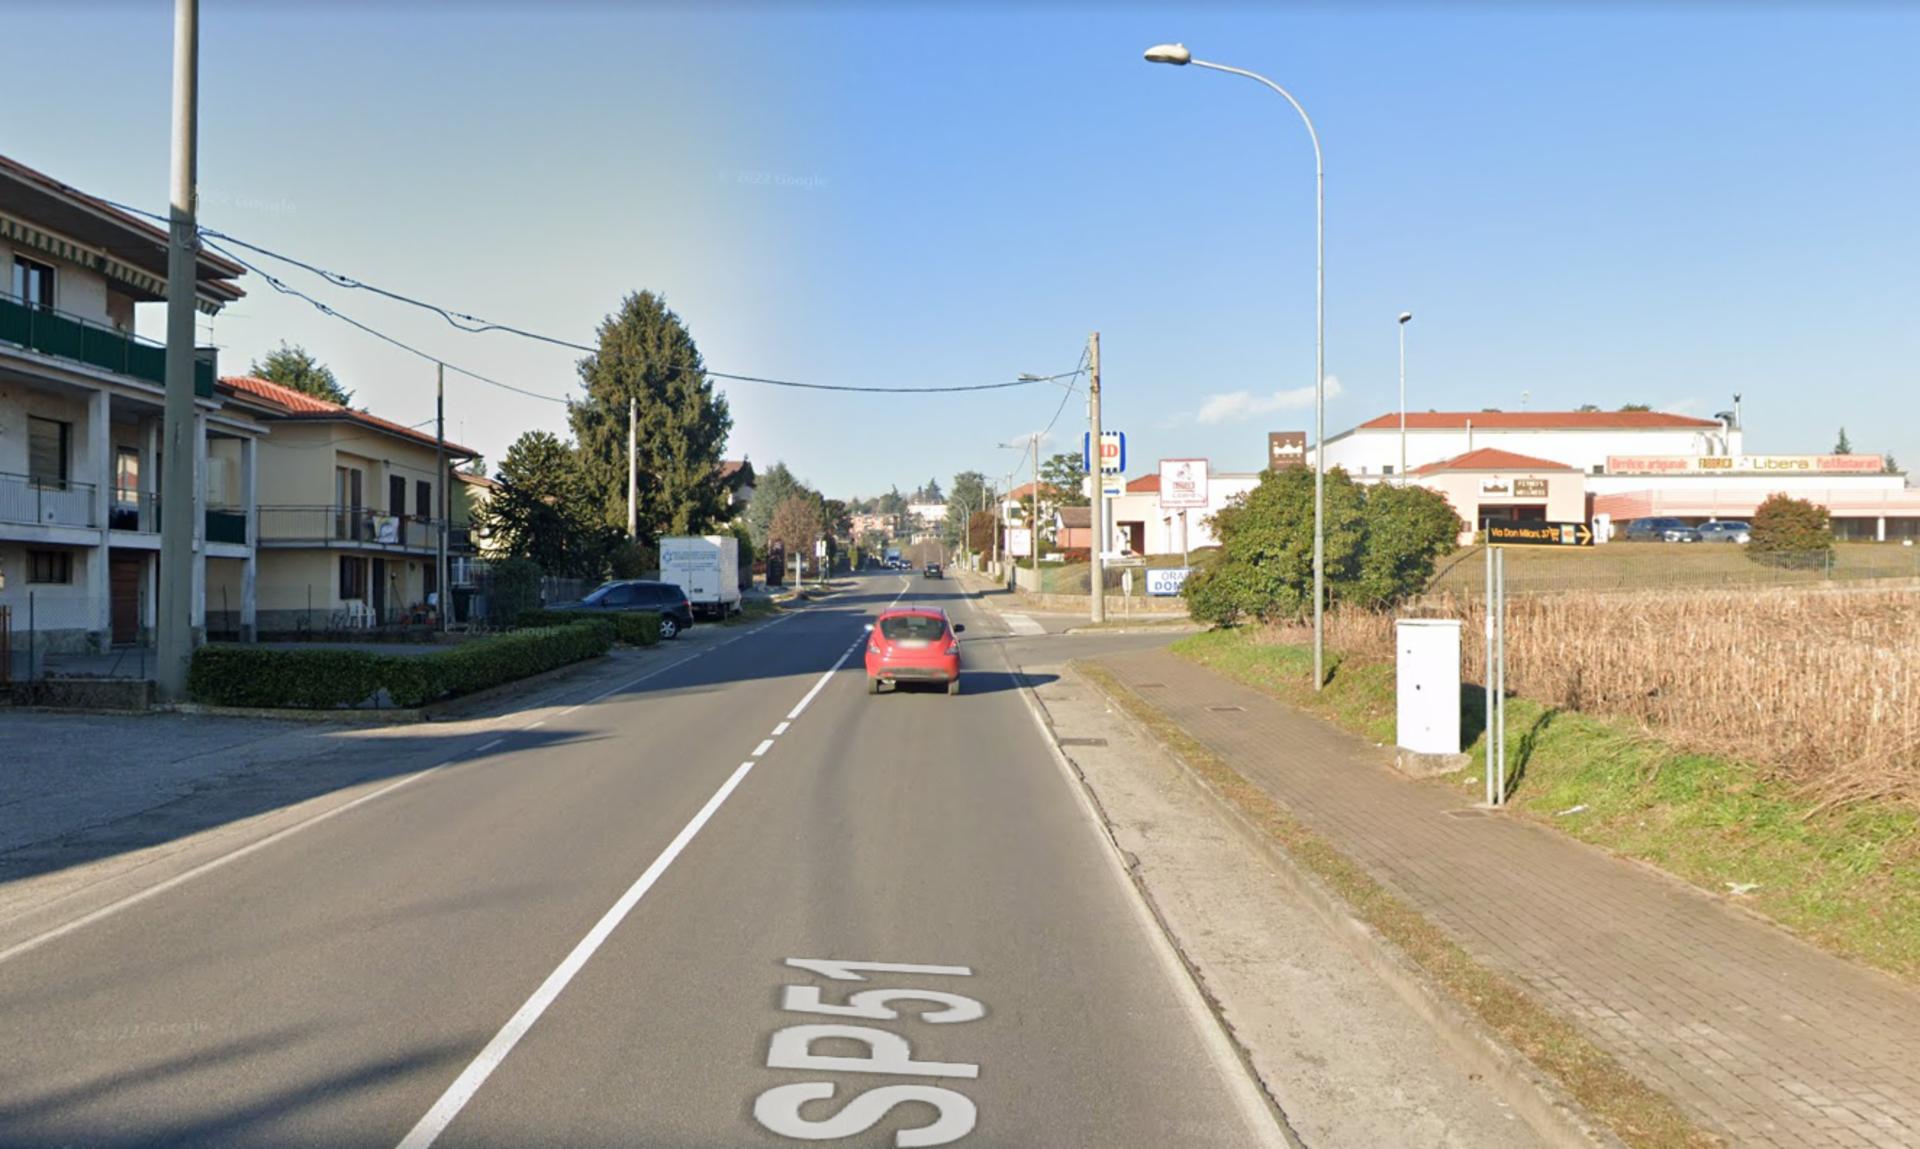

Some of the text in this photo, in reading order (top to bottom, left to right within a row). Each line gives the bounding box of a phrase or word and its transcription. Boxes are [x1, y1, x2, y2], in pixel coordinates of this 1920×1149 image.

[1753, 457, 1809, 469] Libera
[1491, 527, 1503, 537] Via
[1504, 527, 1518, 538] Don
[753, 957, 985, 1148] SP51
